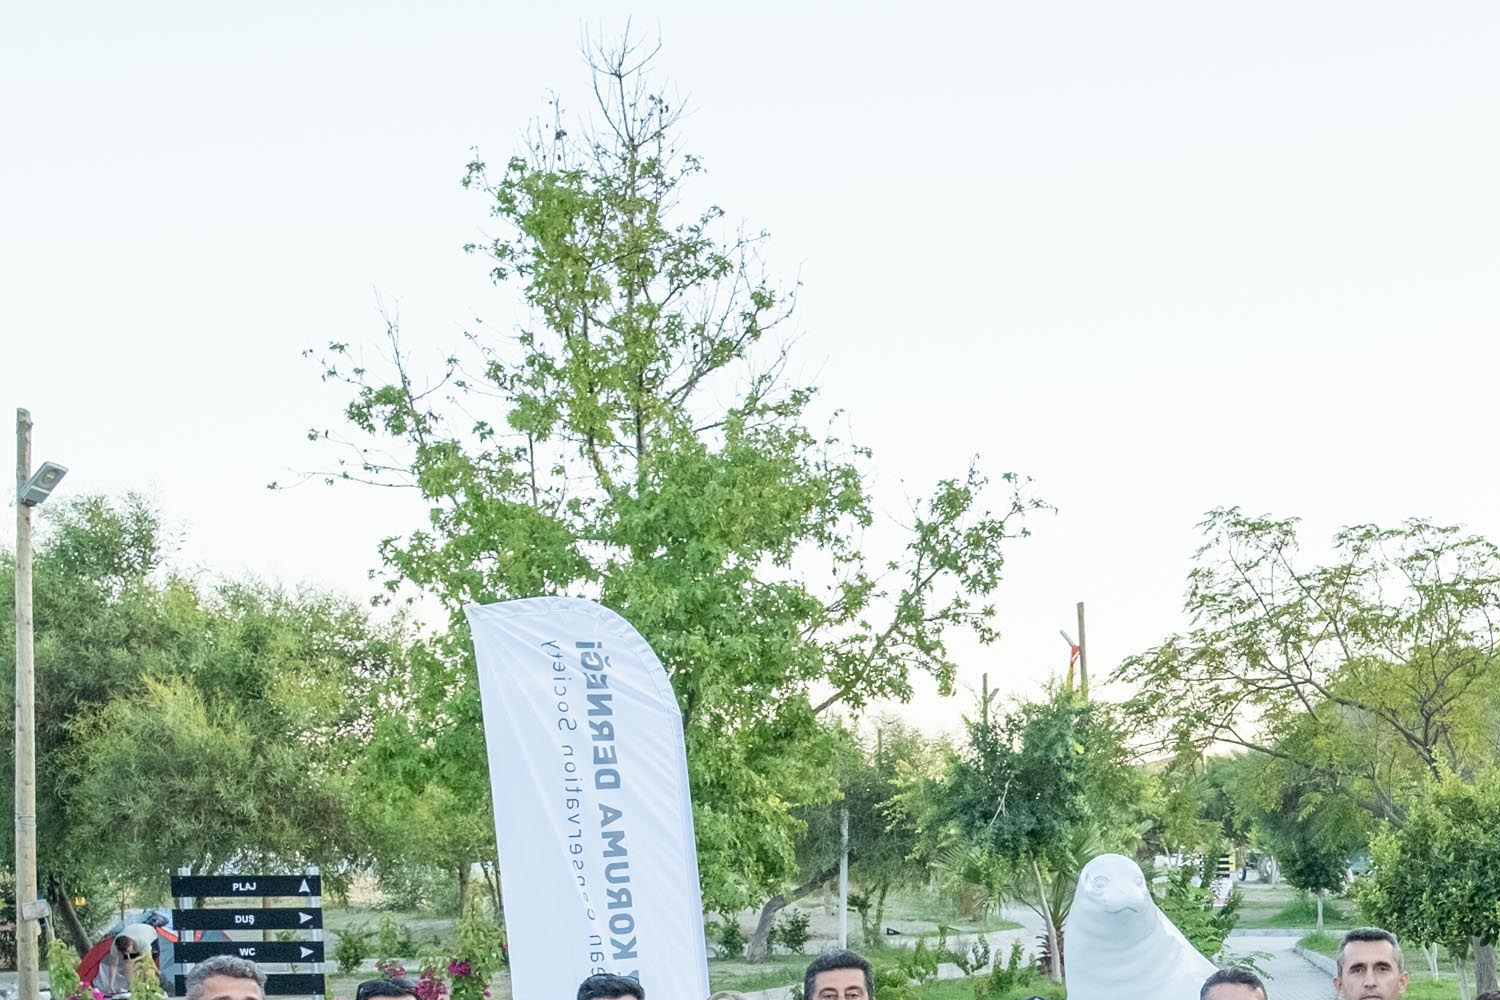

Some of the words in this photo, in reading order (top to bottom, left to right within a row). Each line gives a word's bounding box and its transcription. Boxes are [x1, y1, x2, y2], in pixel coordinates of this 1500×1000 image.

[232, 882, 257, 891] PLAJ
[234, 915, 255, 925] DUŞ
[239, 948, 256, 956] WC
